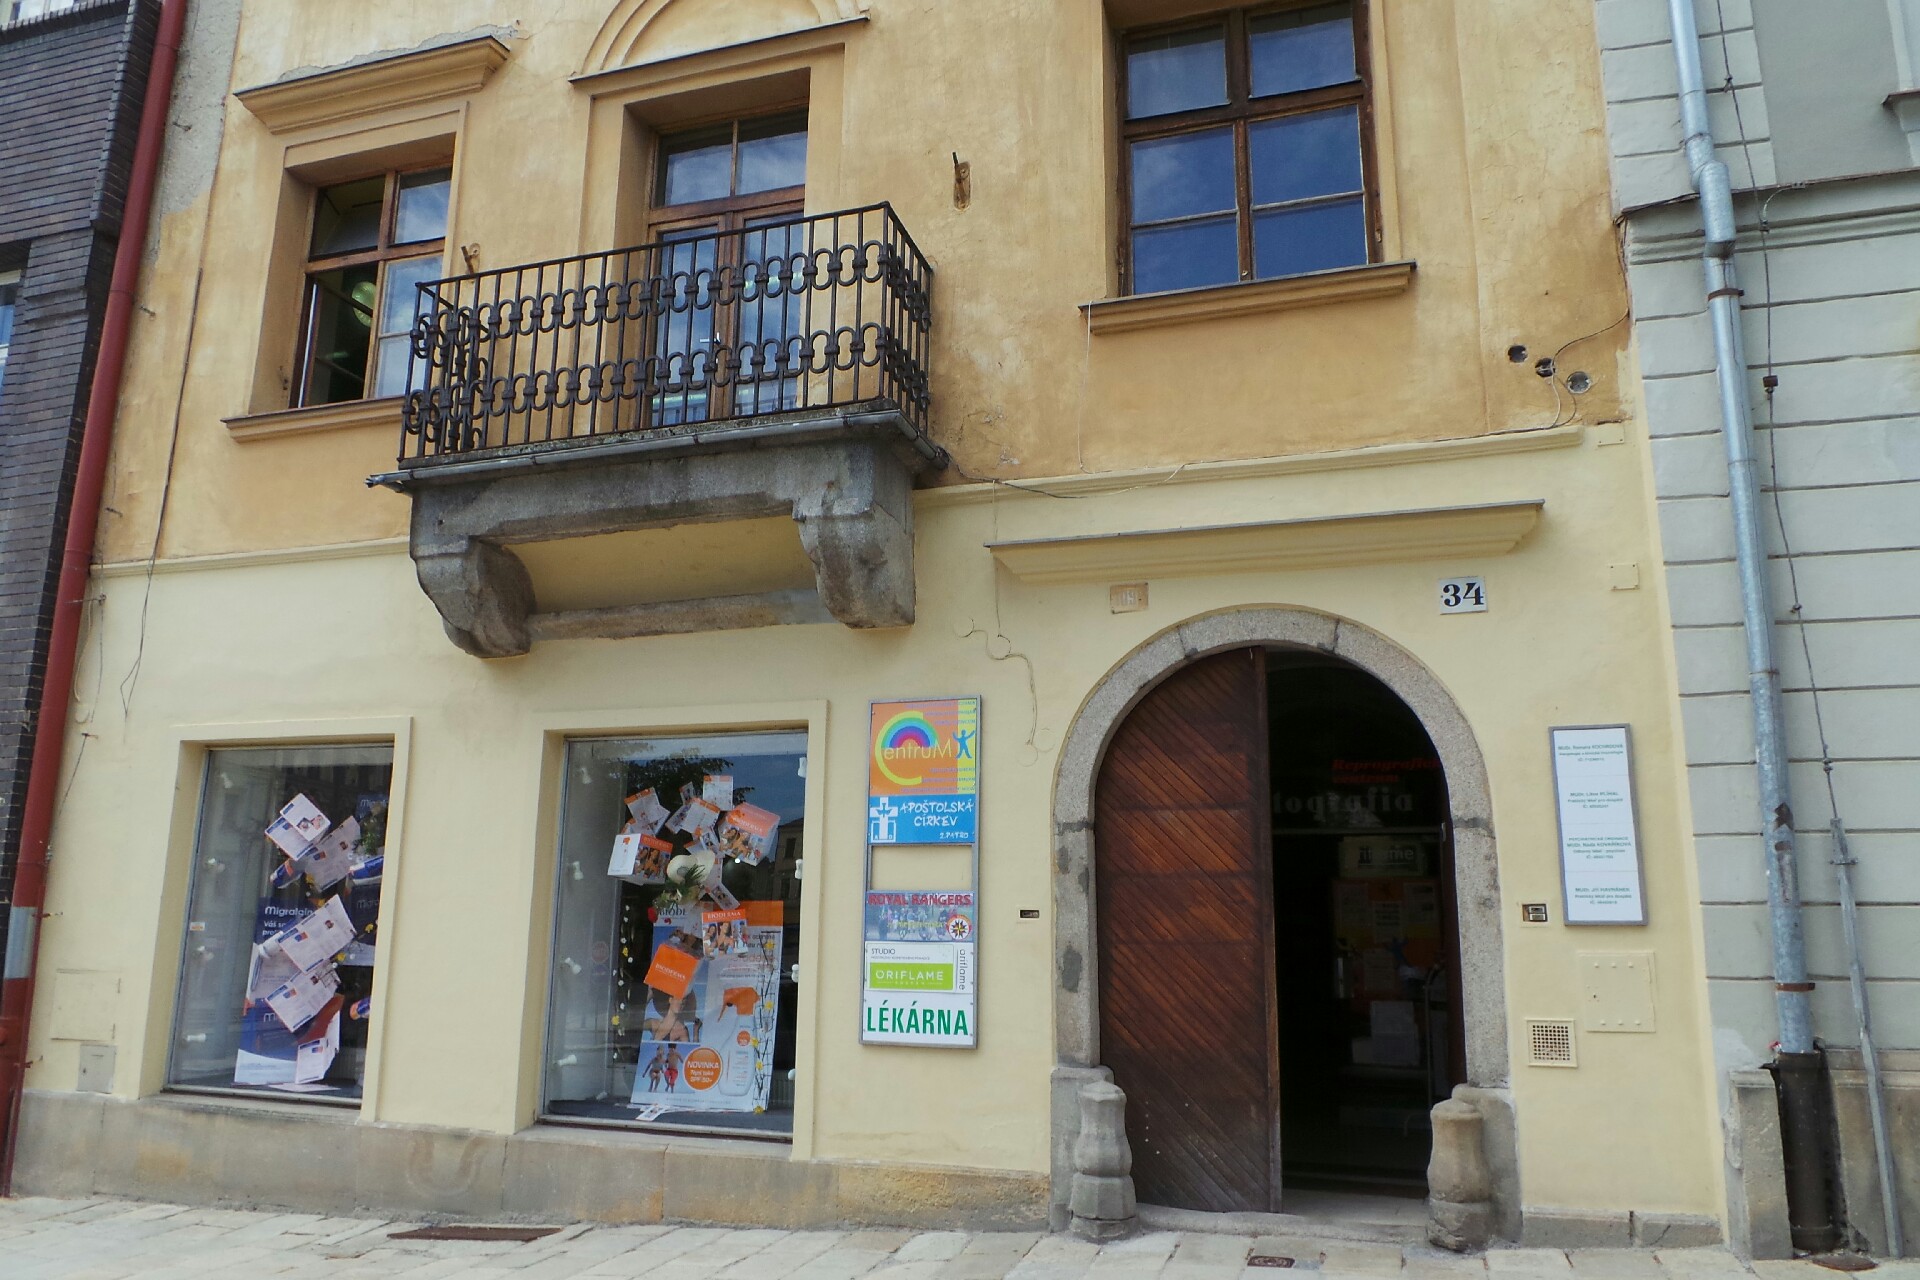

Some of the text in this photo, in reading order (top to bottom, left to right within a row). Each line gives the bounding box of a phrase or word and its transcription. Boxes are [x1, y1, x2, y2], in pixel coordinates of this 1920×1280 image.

[1443, 583, 1484, 607] 34
[899, 799, 975, 814] APOŠTOLSKÁ
[913, 814, 958, 827] CÍRKEV
[868, 893, 972, 906] ROYAL RANGERS
[876, 970, 944, 981] ORIFLAME
[958, 949, 968, 990] oriflame
[867, 1000, 968, 1036] LÉKÁRNA
[687, 1060, 720, 1069] NOVINKA
